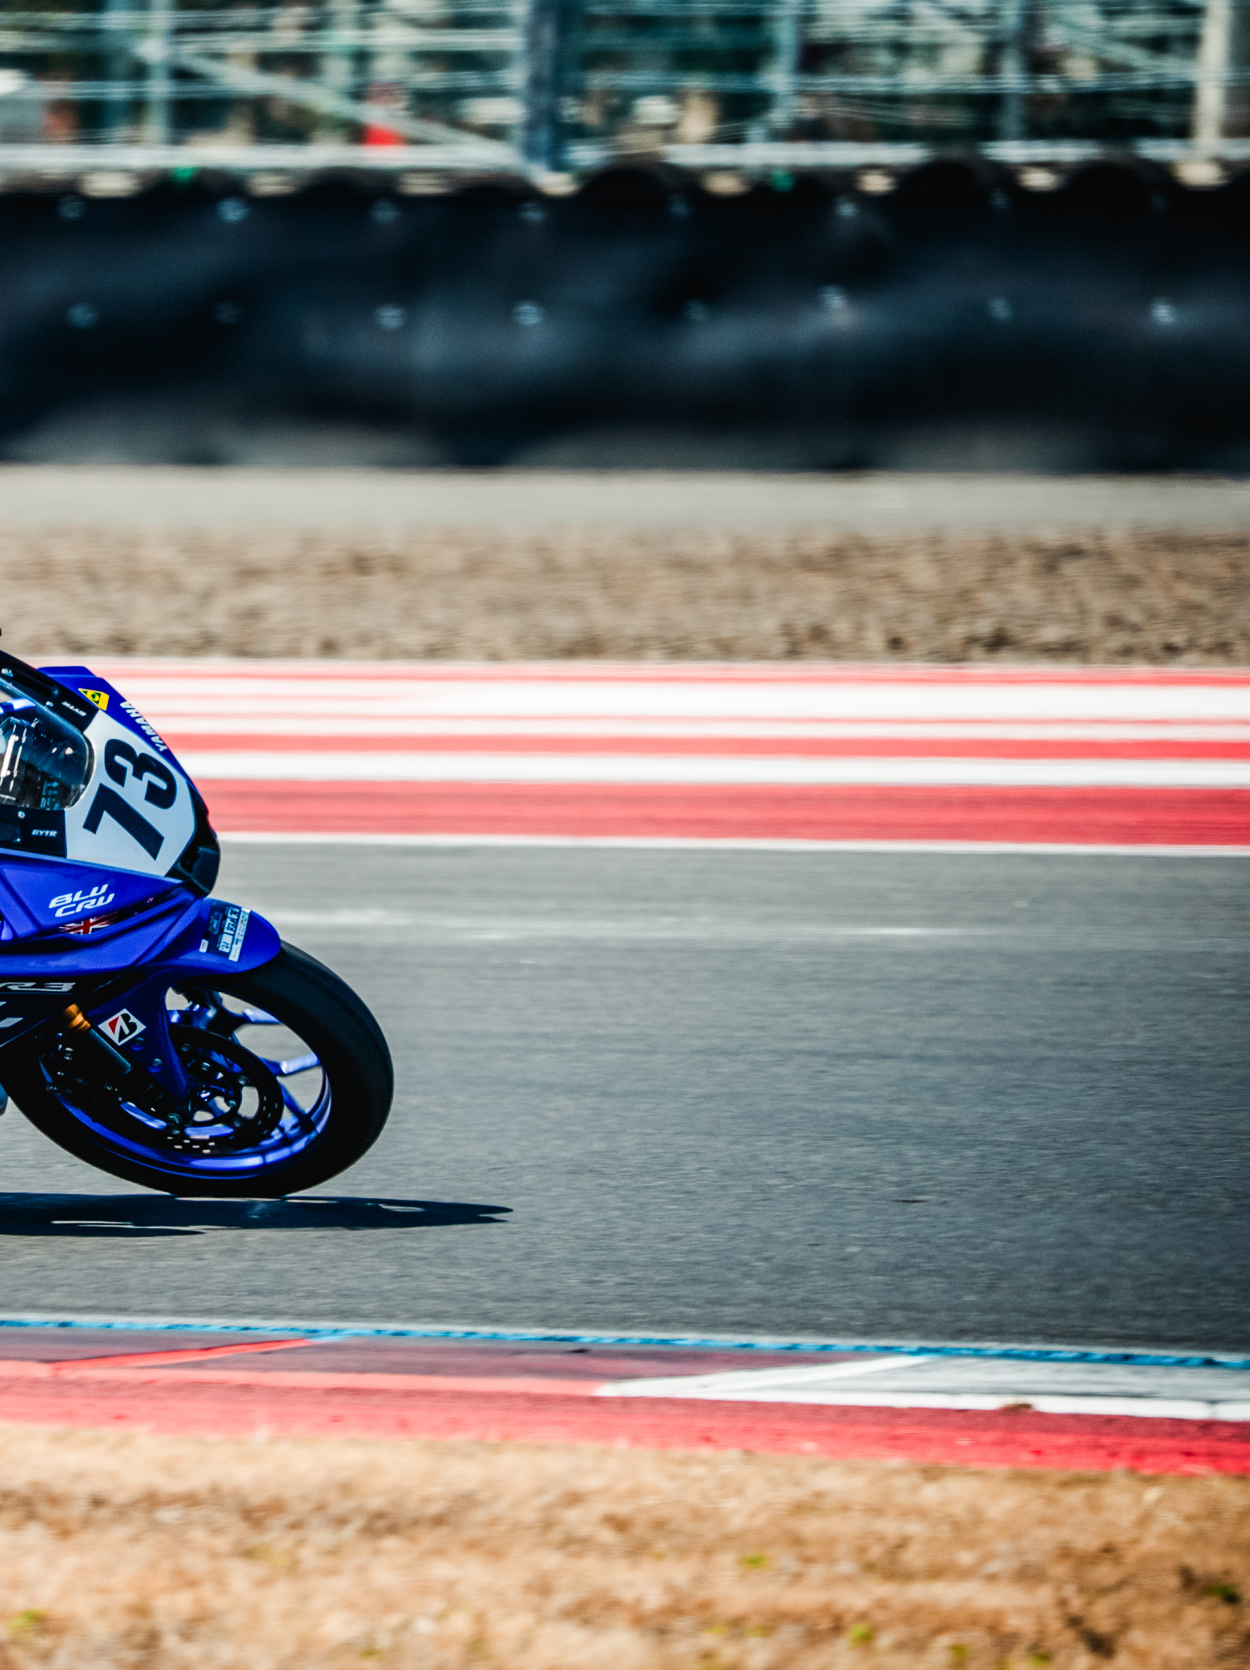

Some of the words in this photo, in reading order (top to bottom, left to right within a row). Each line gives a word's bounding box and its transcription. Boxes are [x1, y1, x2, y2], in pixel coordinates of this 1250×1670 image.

[119, 701, 168, 752] YAMAHA
[83, 739, 177, 860] 73
[49, 884, 108, 909] BLU
[55, 893, 115, 918] CRU
